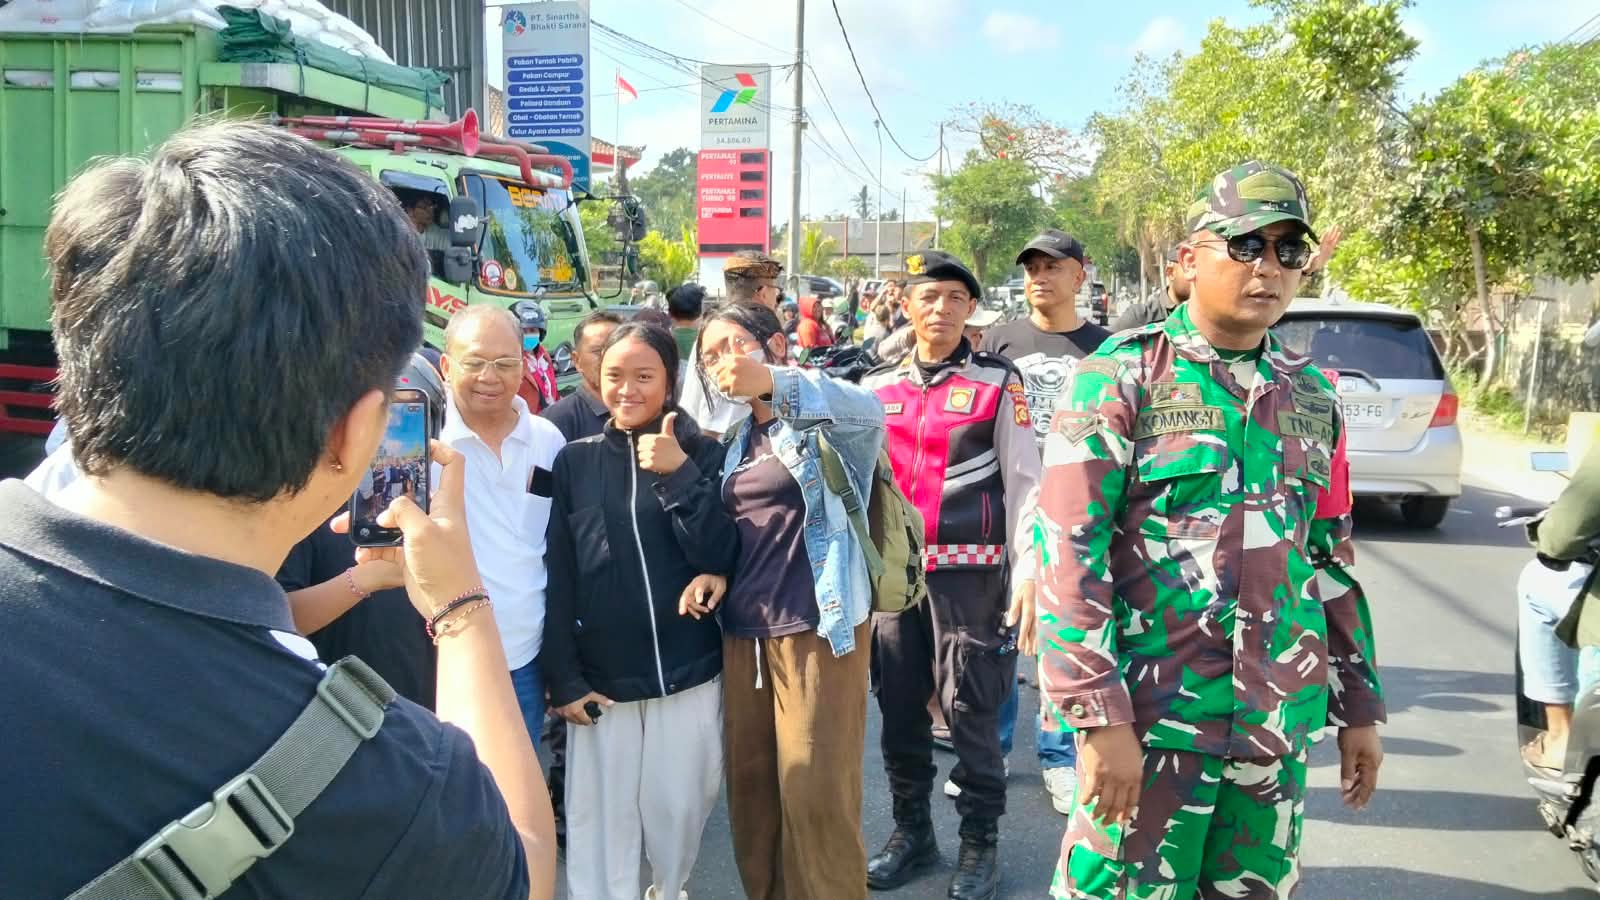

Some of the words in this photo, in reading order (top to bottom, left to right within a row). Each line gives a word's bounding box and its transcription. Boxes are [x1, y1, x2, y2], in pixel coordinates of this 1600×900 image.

[530, 22, 557, 31] Bhakti
[558, 21, 587, 29] Sarana
[543, 71, 570, 79] Campur
[708, 117, 758, 126] PERTAMINA
